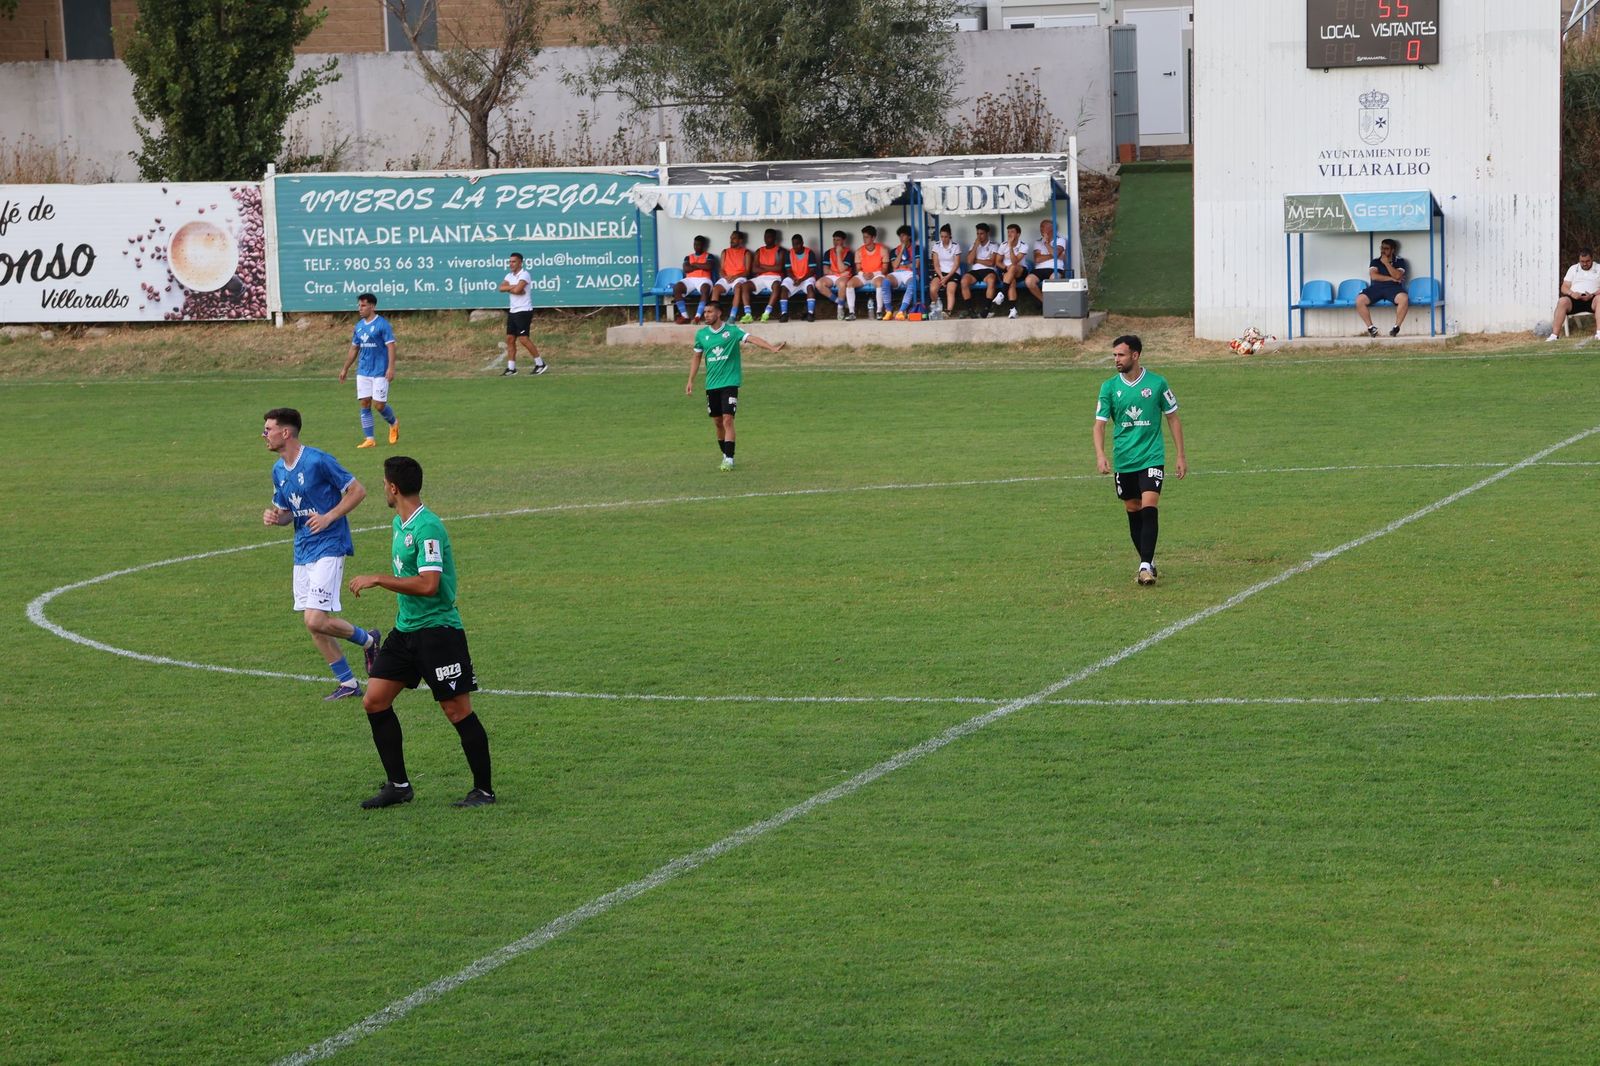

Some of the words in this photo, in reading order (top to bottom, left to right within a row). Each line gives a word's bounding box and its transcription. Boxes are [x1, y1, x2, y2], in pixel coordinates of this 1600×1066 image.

[1320, 24, 1360, 39] LOCAL
[1371, 21, 1437, 37] VISITANTES
[1407, 40, 1420, 60] 0
[1319, 148, 1412, 159] AYUNTAMIENTO
[1415, 147, 1431, 157] DE
[1318, 162, 1431, 176] VILLARALBO
[300, 188, 435, 213] VIVEROS
[442, 186, 487, 210] LA
[496, 182, 640, 213] PERGOLA
[668, 188, 854, 218] TALLERES
[28, 195, 56, 221] de
[1287, 206, 1344, 219] METAL
[302, 227, 369, 246] VENTA
[376, 226, 402, 245] DE
[409, 224, 498, 244] PLANTAS
[503, 223, 516, 242] Y
[525, 216, 642, 240] JARDINERÍA
[304, 258, 340, 271] TELF.:
[344, 258, 369, 270] 980
[374, 257, 391, 270] 53
[396, 257, 413, 269] 66
[417, 256, 434, 269] 33
[448, 251, 643, 270] viveroslaprgola@hotmail.com
[305, 280, 338, 294] Ctra.
[343, 278, 409, 296] Moraleja,
[414, 278, 439, 292] Km.
[445, 278, 453, 291] 3
[459, 277, 497, 295] (junto
[530, 274, 560, 292] nda)
[576, 274, 643, 289] ZAMORA
[41, 288, 130, 309] Villaralbo
[435, 663, 462, 681] gaza
